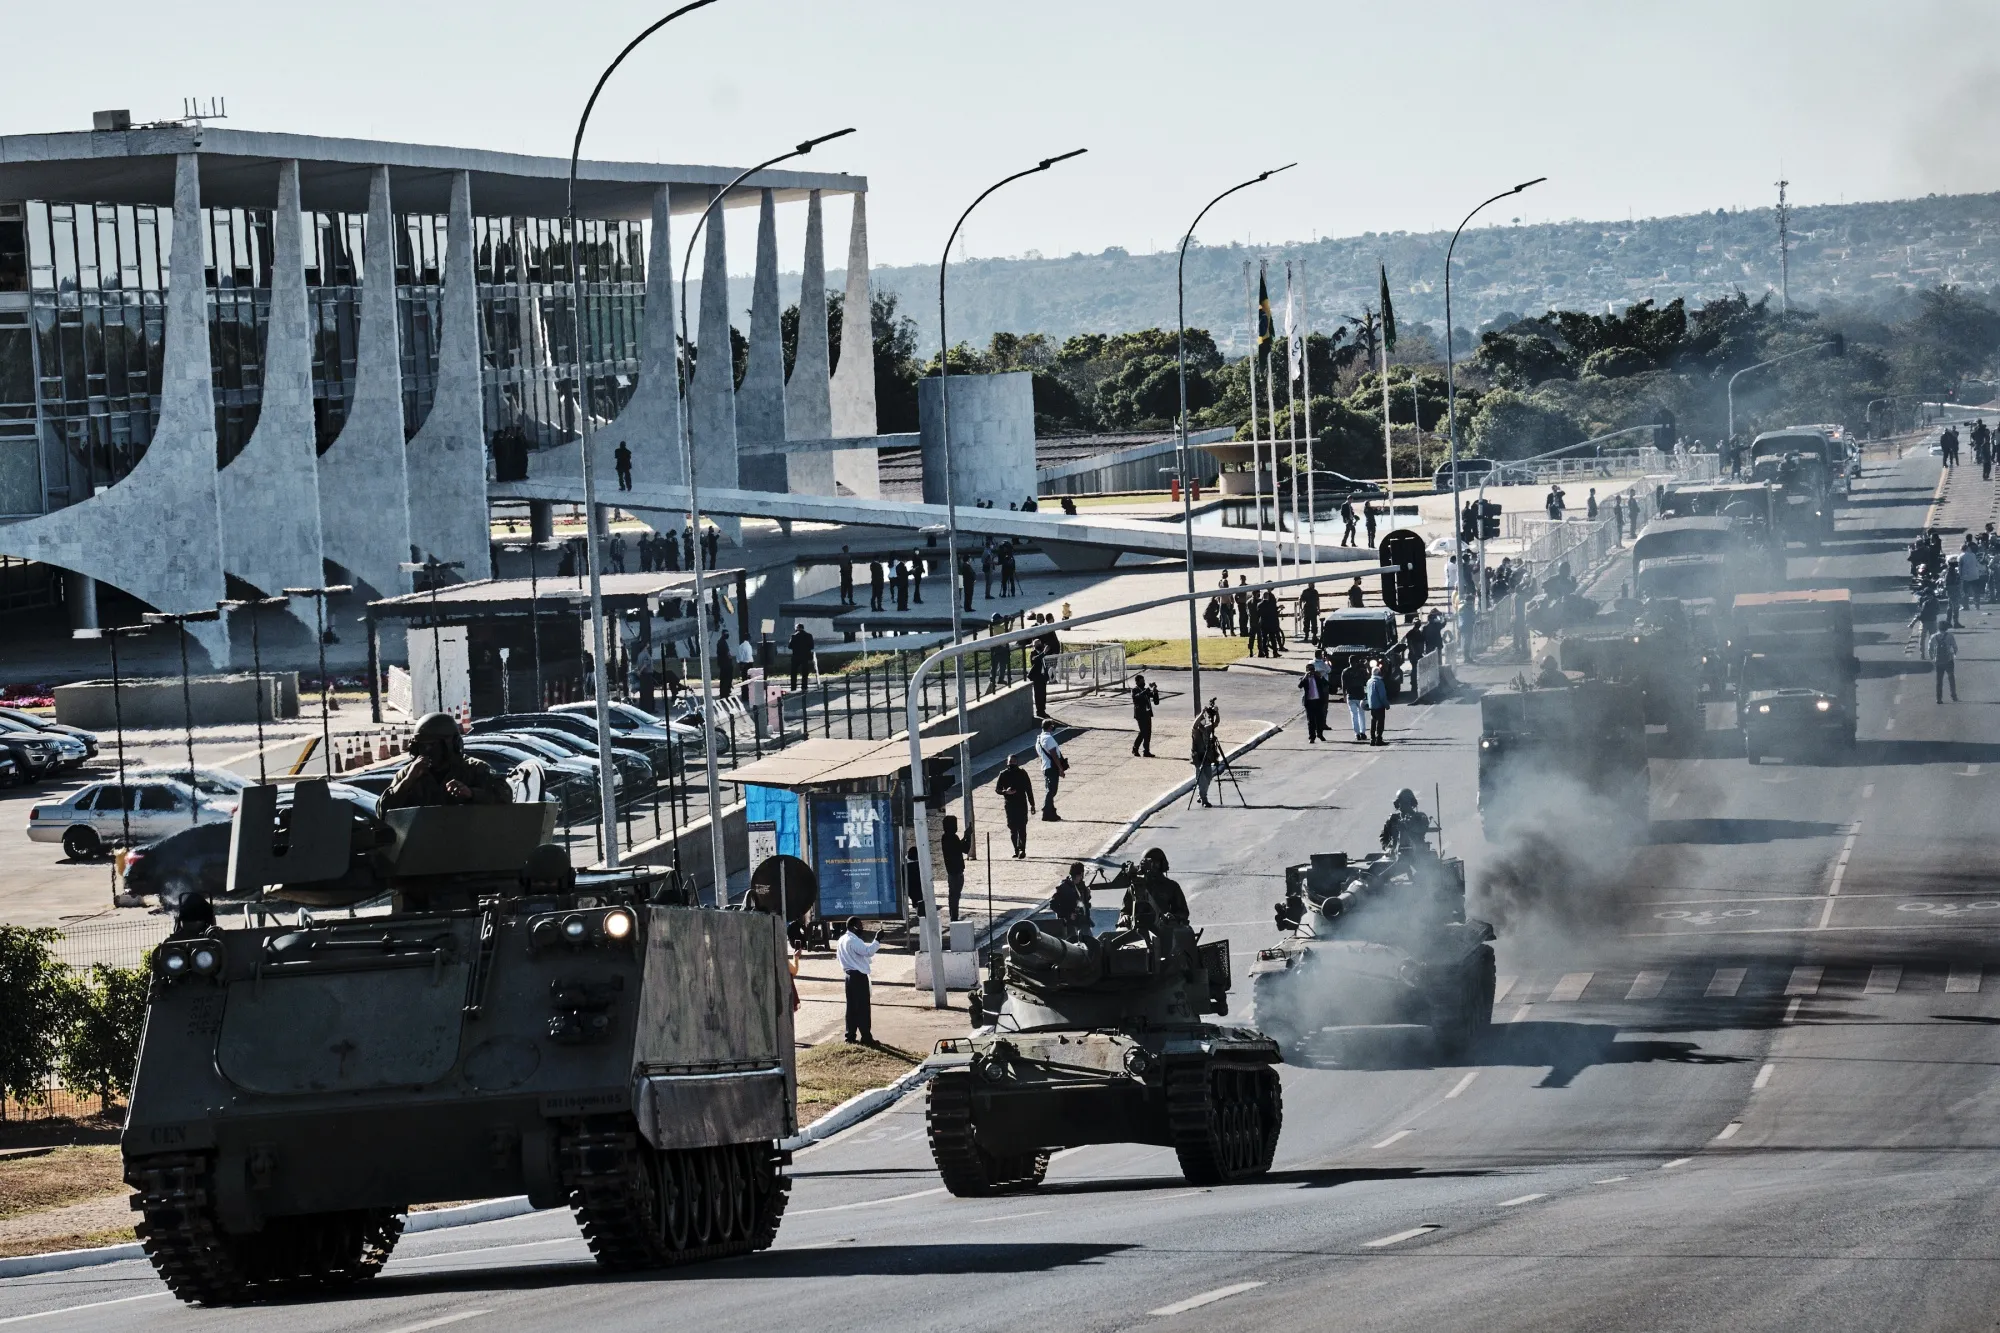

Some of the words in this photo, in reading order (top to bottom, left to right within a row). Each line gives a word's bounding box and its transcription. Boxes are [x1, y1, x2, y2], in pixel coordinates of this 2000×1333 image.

[851, 808, 880, 821] MA
[843, 822, 874, 835] RIS
[835, 835, 862, 848] TA
[150, 1125, 187, 1144] CEN
